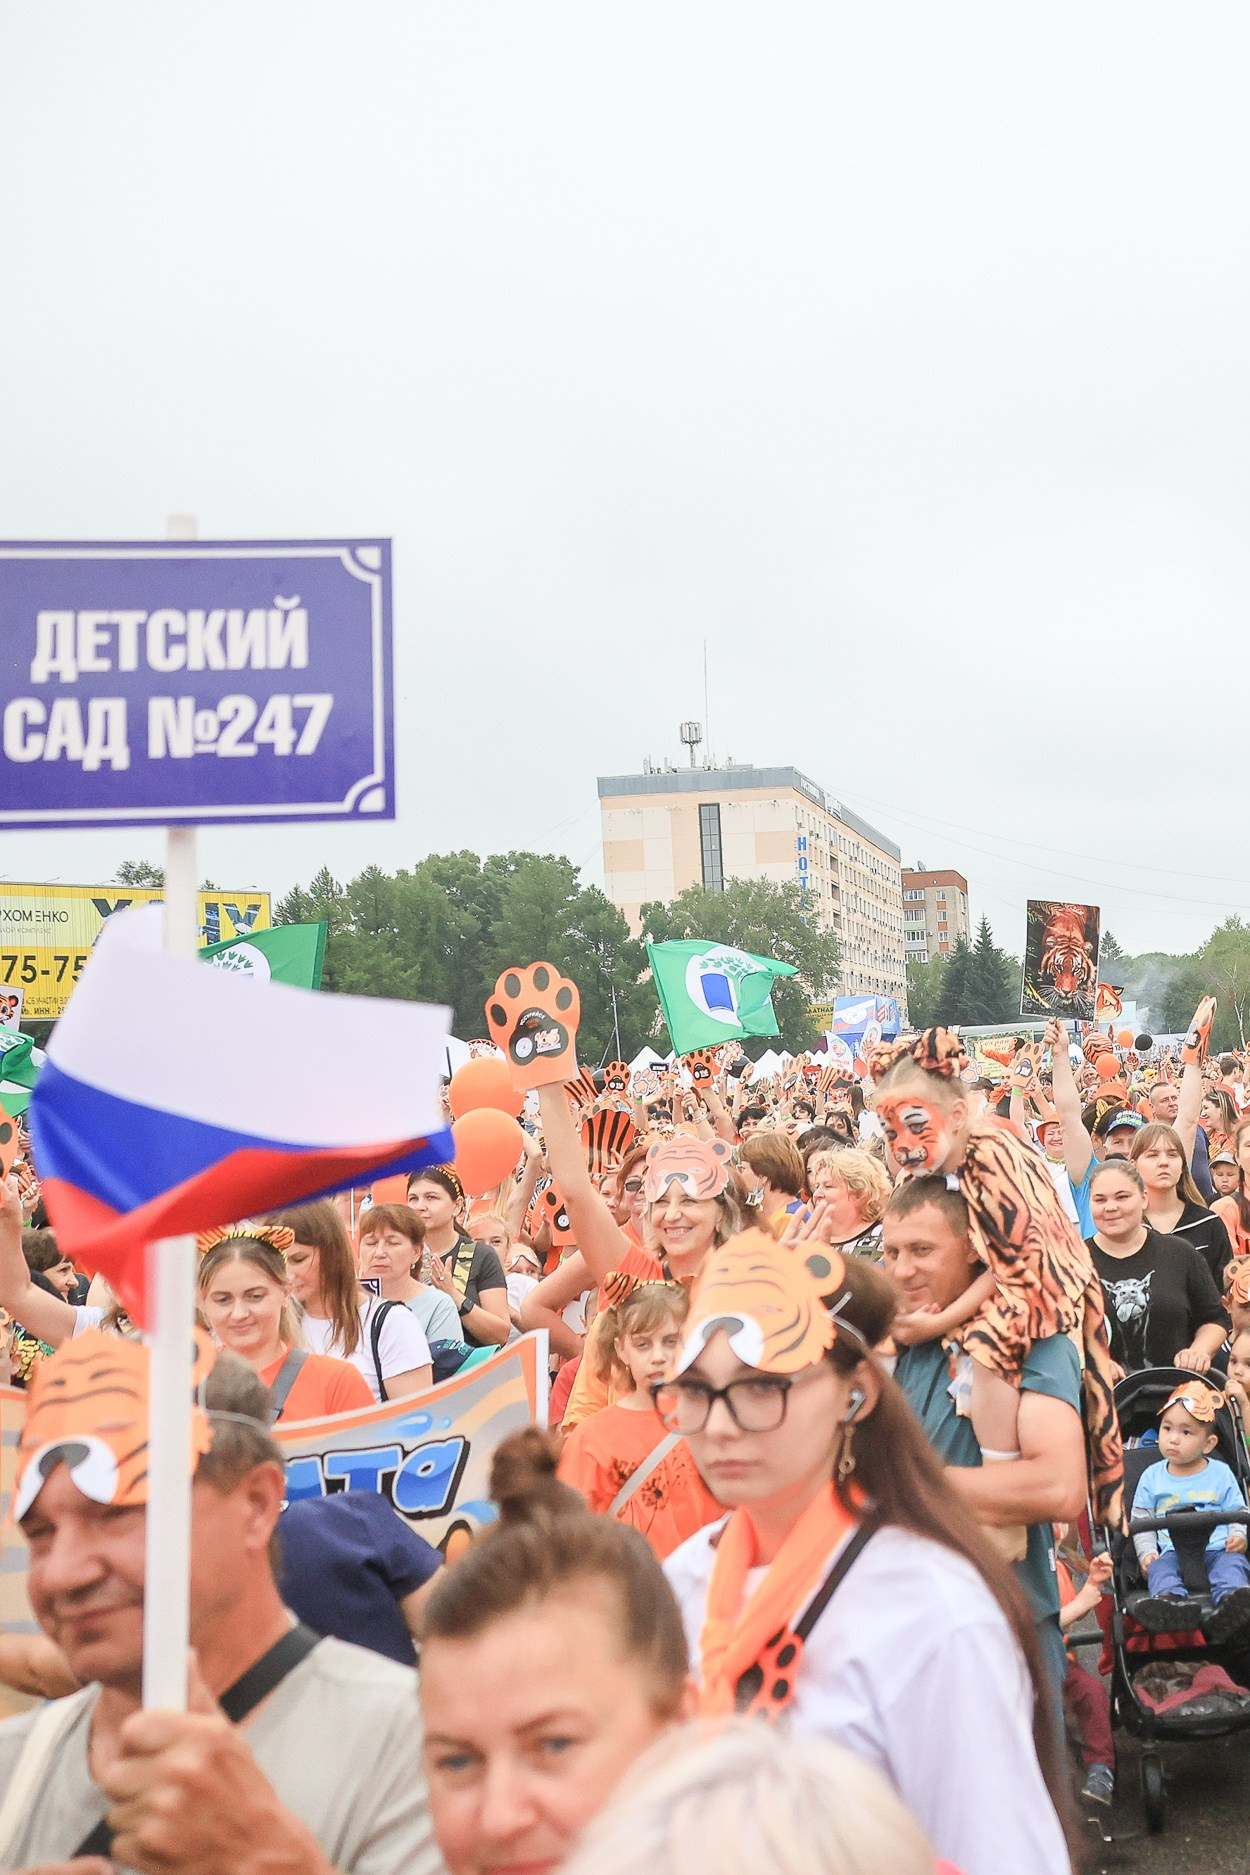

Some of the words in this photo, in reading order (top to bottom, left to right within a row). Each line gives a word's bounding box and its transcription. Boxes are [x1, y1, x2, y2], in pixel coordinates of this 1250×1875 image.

[30, 594, 310, 683] ДЕТСКИЙ
[3, 696, 131, 771] САД
[147, 693, 334, 760] №247
